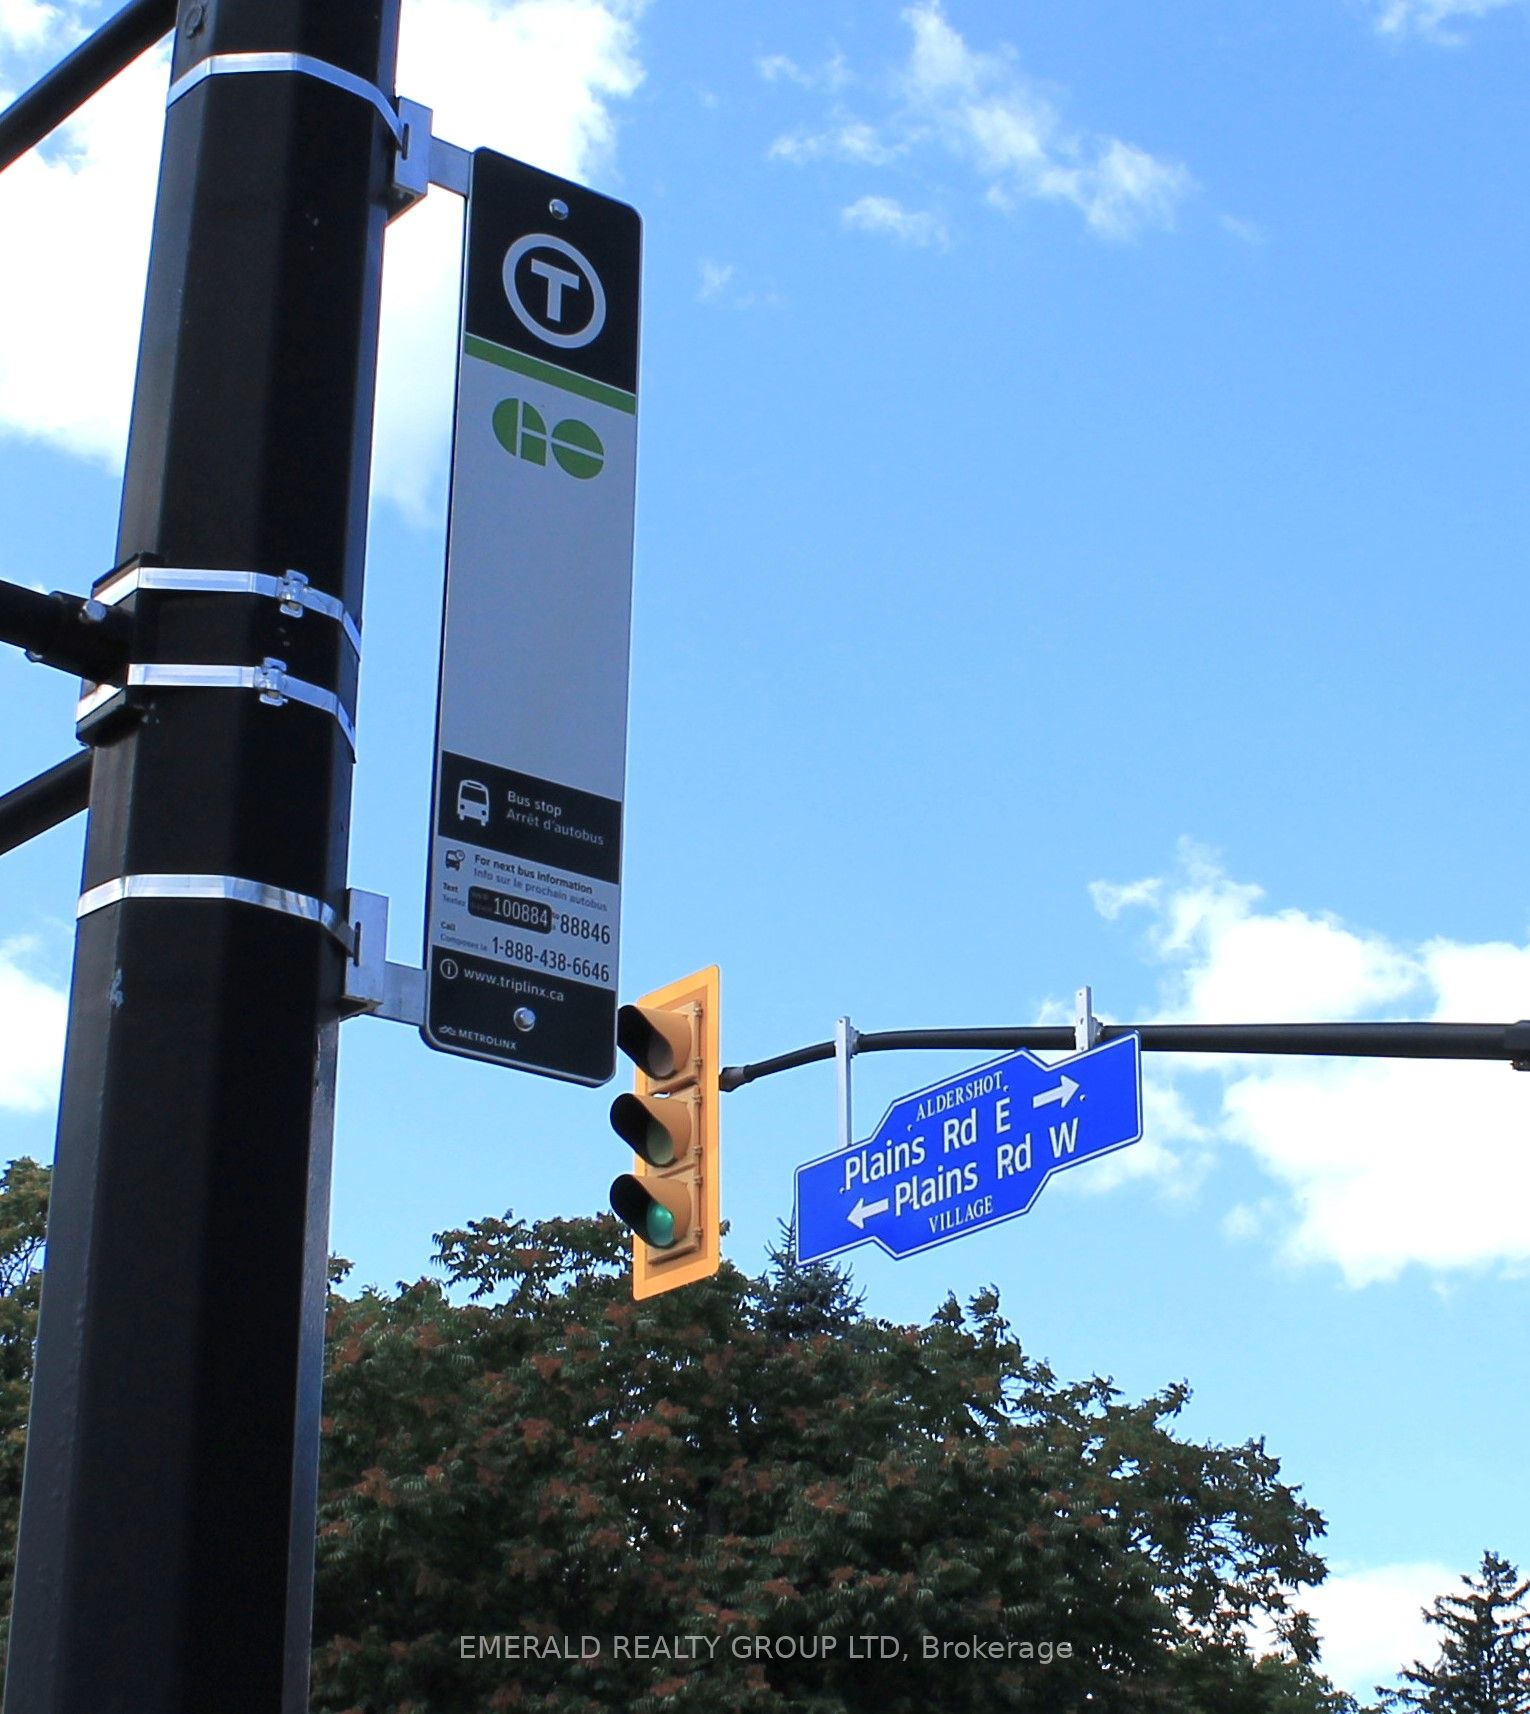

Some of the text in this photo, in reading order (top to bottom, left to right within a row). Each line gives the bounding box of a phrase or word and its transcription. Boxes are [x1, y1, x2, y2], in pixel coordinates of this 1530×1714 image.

[492, 397, 605, 480] GO
[507, 790, 562, 818] Bus stop
[506, 808, 604, 846] Arrêt d'autobus
[442, 882, 459, 894] Text
[474, 854, 593, 895] For next bus information
[474, 868, 608, 912] Info sur le prochain autobus
[440, 920, 456, 932] Call
[494, 897, 548, 928] 100884
[560, 913, 611, 945] 88846
[492, 936, 610, 982] 1-888-438-6646
[464, 967, 565, 1002] www.triplinx.ca
[458, 1029, 517, 1050] METROLINX
[915, 1070, 1003, 1122] ALDERSHOT
[844, 1097, 1012, 1191] Plains Rd E
[895, 1117, 1079, 1217] Plains Rd W
[928, 1195, 994, 1234] VILLAGE
